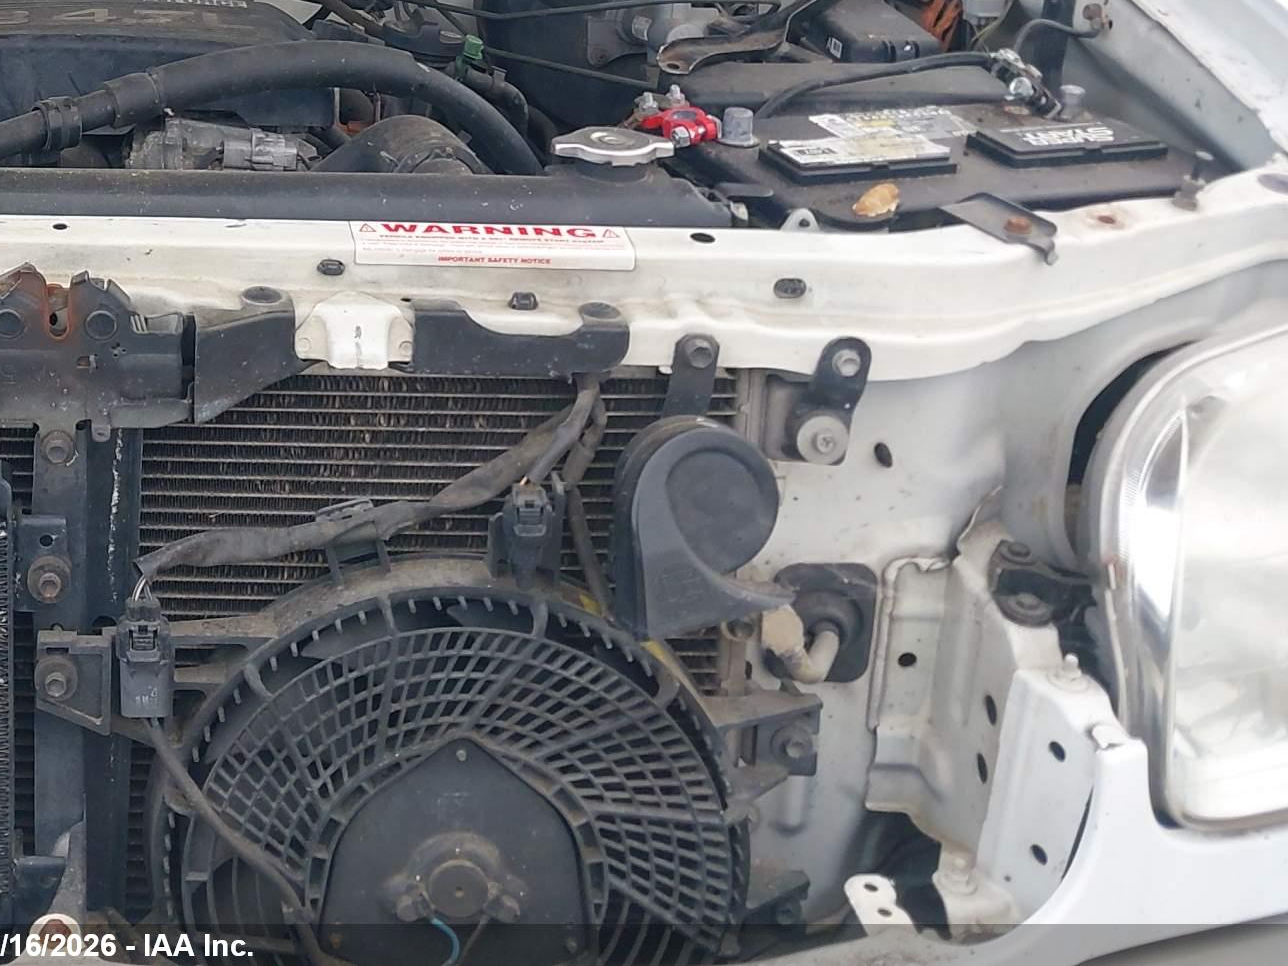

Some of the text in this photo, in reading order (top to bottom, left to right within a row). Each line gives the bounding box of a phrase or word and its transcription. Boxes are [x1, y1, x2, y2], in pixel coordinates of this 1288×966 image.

[382, 223, 597, 238] WARNING
[438, 255, 552, 265] IMPORTANT SAFETY NOTICE
